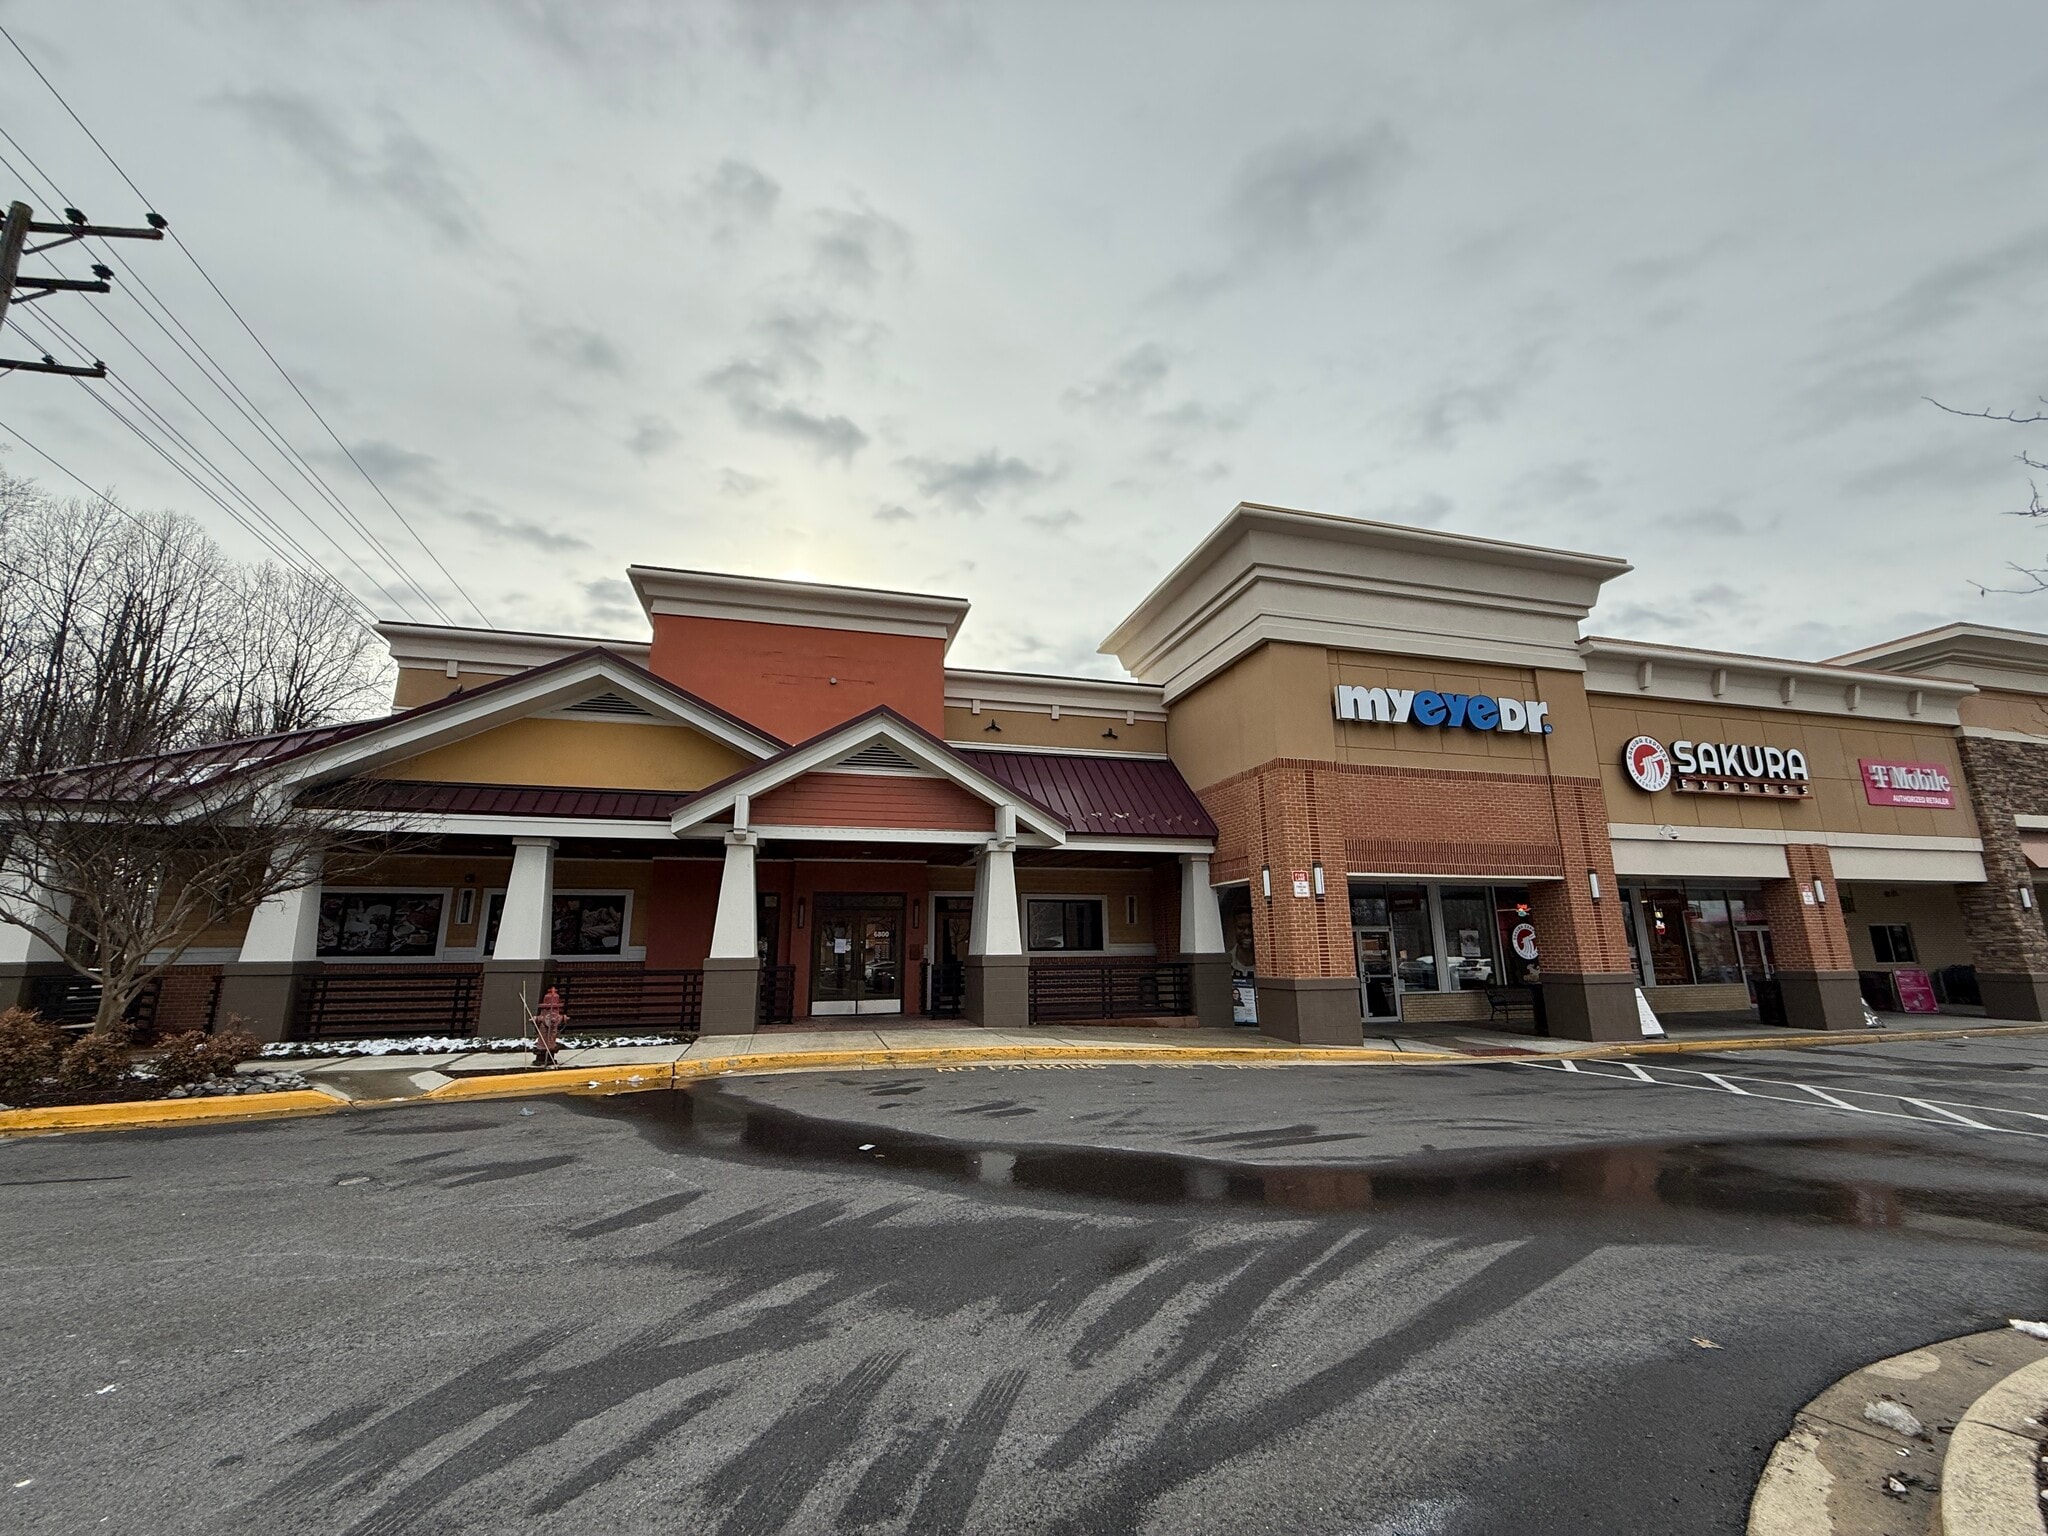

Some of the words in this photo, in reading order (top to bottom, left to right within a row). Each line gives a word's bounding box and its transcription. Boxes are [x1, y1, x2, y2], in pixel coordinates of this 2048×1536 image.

[1628, 738, 1643, 760] SAKURA
[1670, 740, 1809, 780] SAKURA
[1681, 779, 1809, 794] EXPRESS
[1887, 766, 1951, 792] Mobile
[988, 1063, 1107, 1071] PARKING
